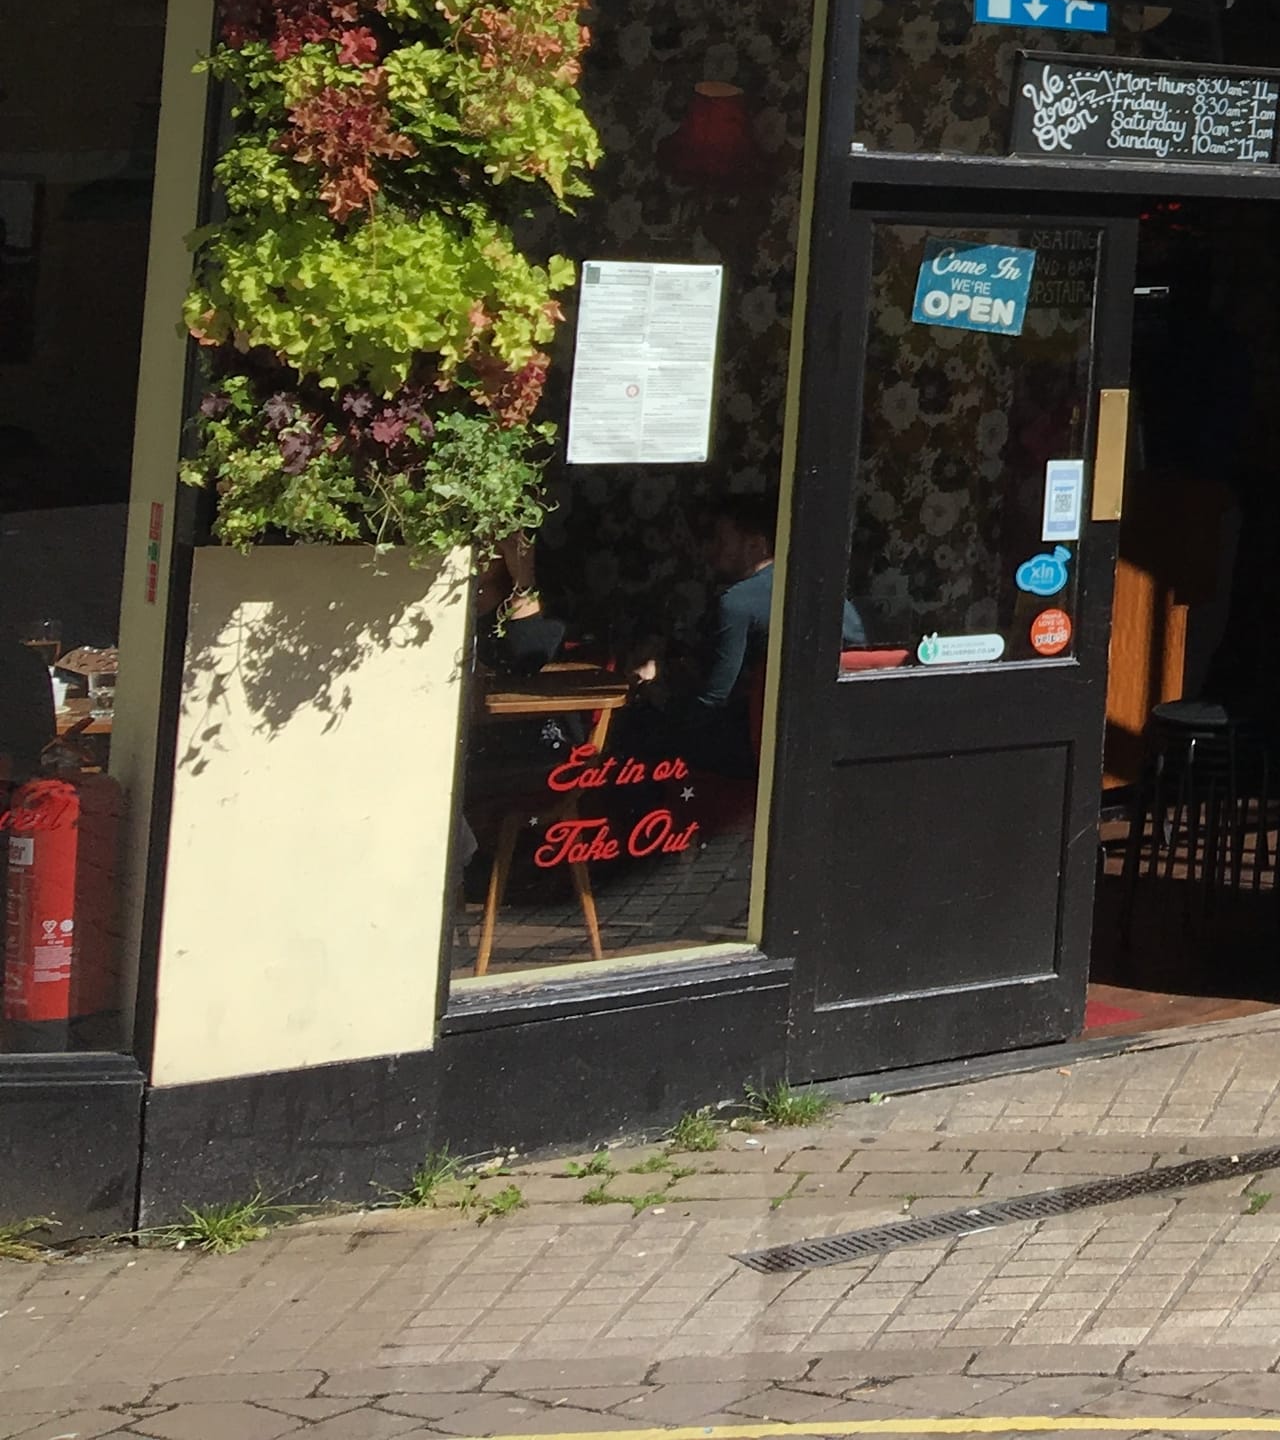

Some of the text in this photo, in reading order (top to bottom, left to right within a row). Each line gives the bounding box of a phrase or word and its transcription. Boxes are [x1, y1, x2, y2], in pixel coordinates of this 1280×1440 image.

[1022, 65, 1064, 110] We
[1111, 111, 1187, 142] Saturday
[932, 247, 1022, 281] Come In
[951, 278, 992, 294] WE'RE
[923, 290, 1016, 326] OPEN
[547, 743, 689, 792] Eat in or
[534, 809, 699, 868] Take Out
